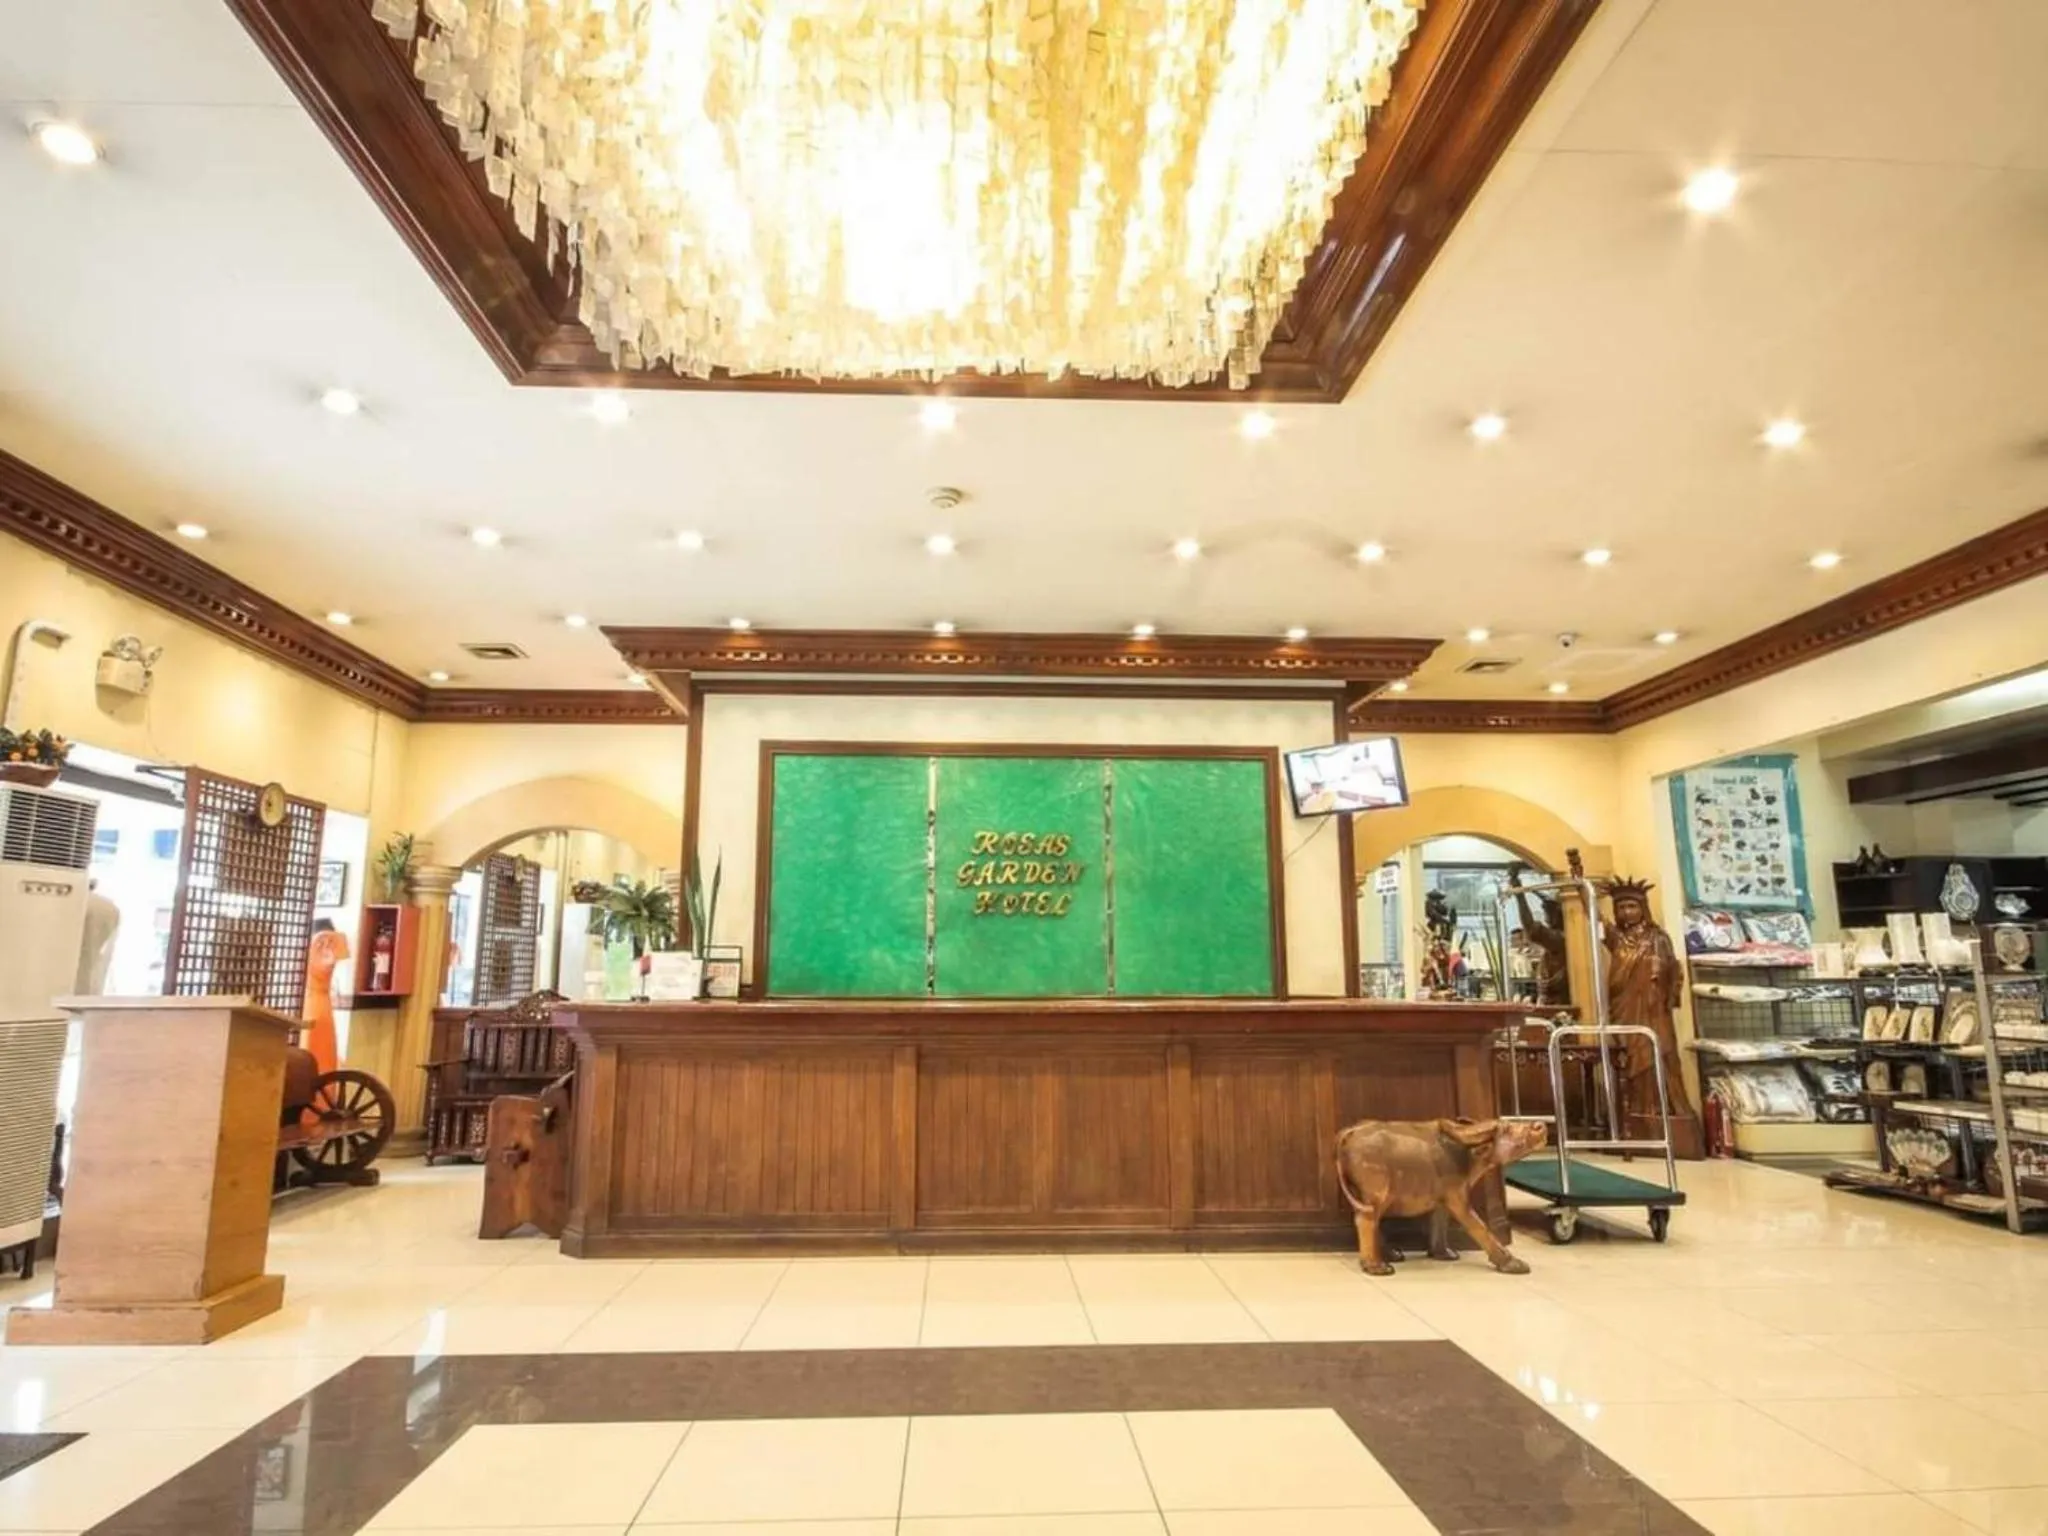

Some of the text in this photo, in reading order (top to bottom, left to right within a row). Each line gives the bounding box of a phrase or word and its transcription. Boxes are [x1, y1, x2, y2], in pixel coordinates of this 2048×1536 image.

[972, 831, 1071, 856] ROSAS
[957, 861, 1083, 887] GARDEN
[974, 891, 1072, 915] HOTEL
